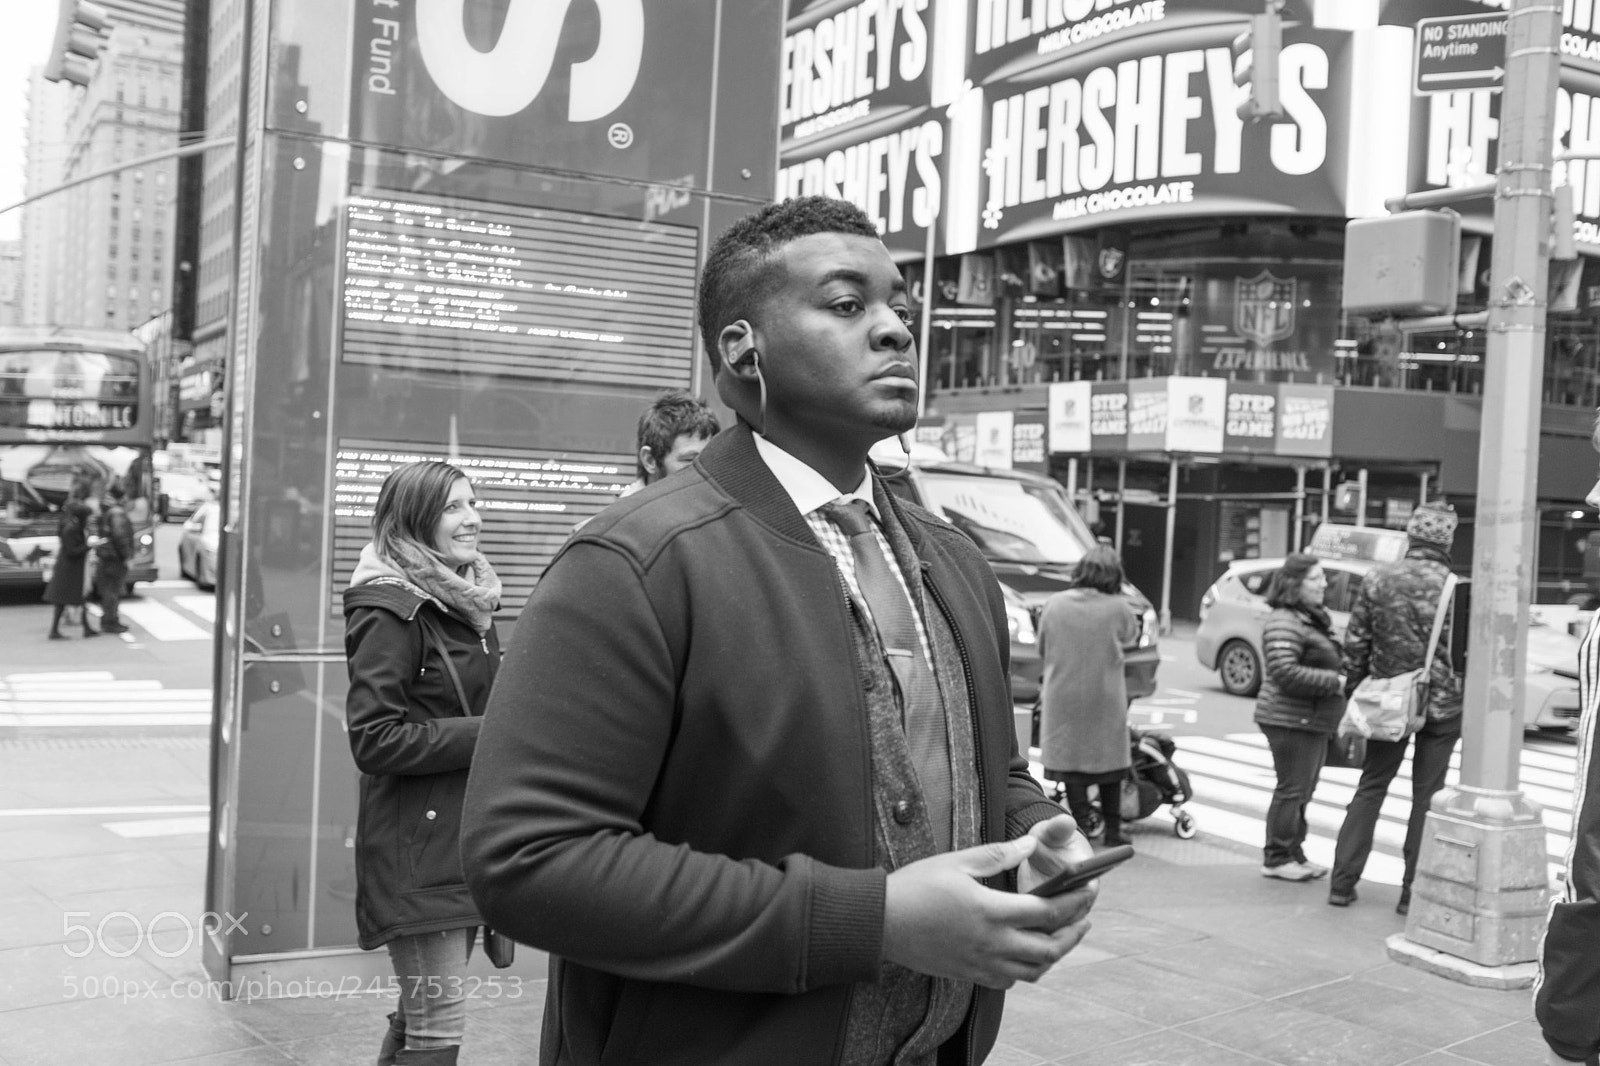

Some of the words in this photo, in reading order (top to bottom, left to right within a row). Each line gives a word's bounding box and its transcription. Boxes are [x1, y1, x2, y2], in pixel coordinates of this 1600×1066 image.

[1070, 0, 1166, 44] CHOCOLATE
[1424, 26, 1443, 41] NO
[368, 17, 400, 95] Fund
[1423, 42, 1478, 60] Anytime
[988, 43, 1329, 208] HERSHEYS
[1052, 195, 1087, 221] MILK
[1086, 181, 1194, 214] CHOCOLATE
[1228, 393, 1275, 413] STEP
[1226, 420, 1274, 438] GAME
